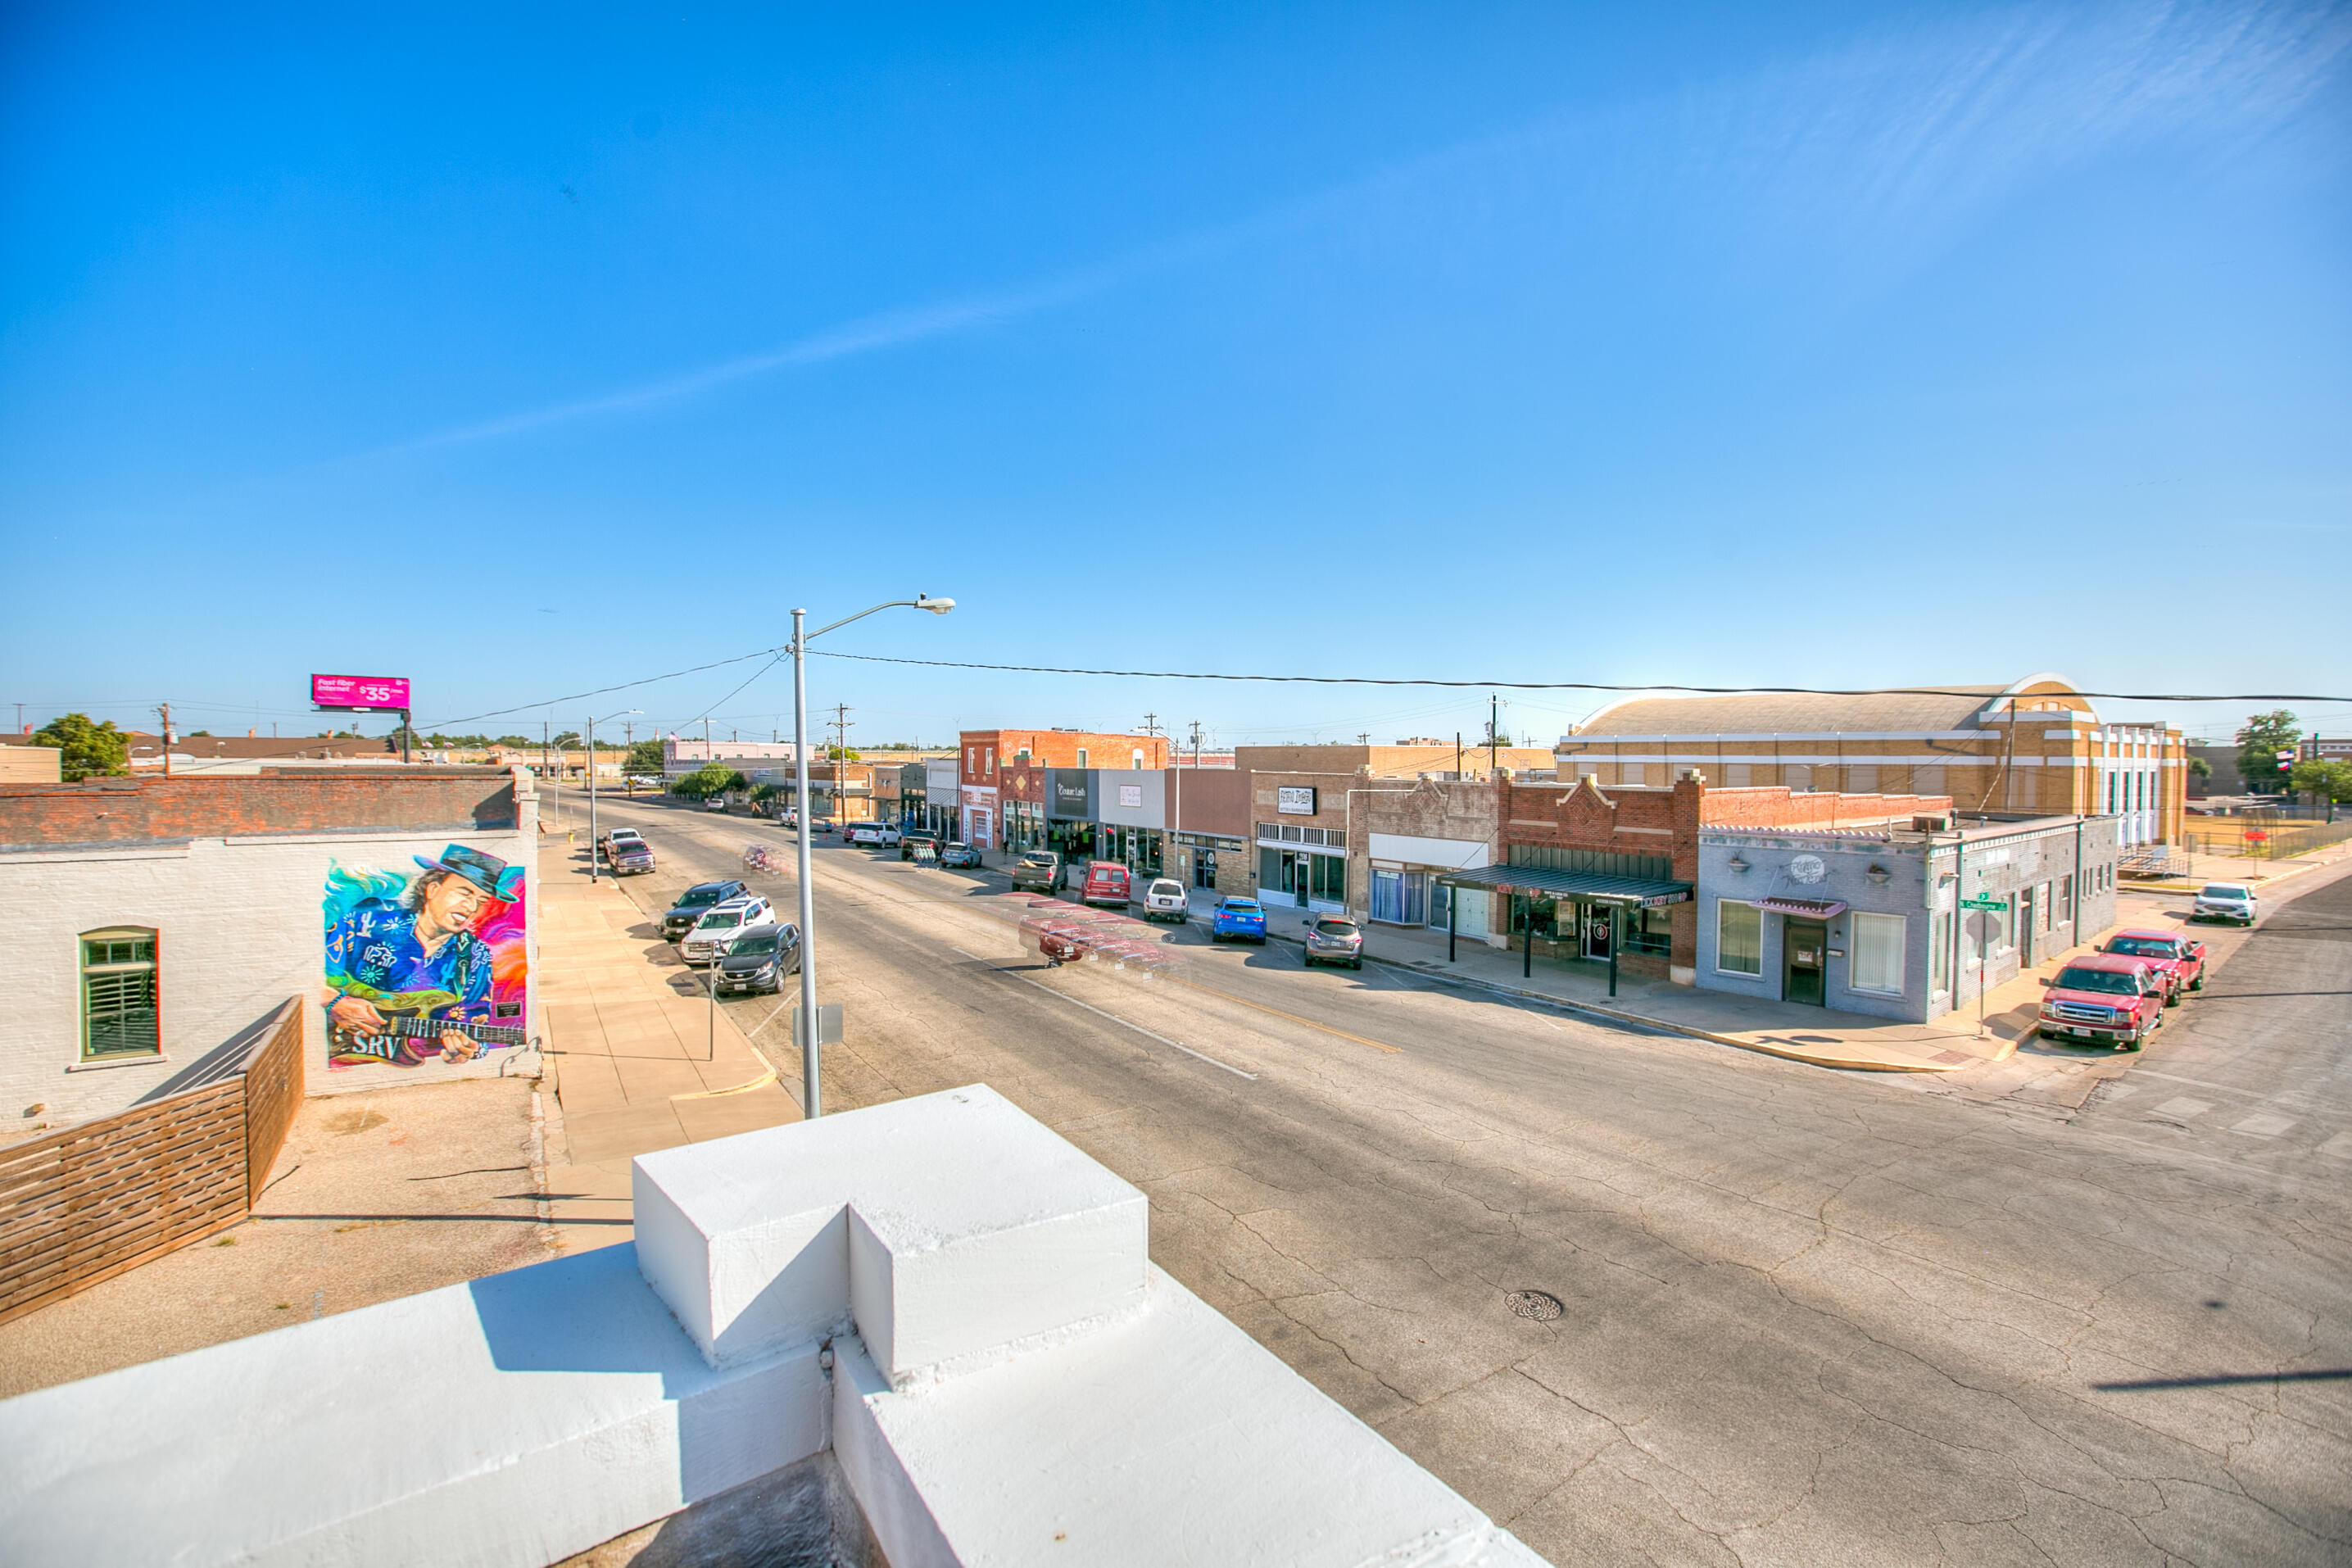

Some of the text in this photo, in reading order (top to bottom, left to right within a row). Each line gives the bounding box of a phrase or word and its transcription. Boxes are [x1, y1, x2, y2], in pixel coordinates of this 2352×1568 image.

[318, 678, 336, 687] Fast
[1497, 884, 1513, 894] KEY
[351, 1029, 401, 1059] SRV
